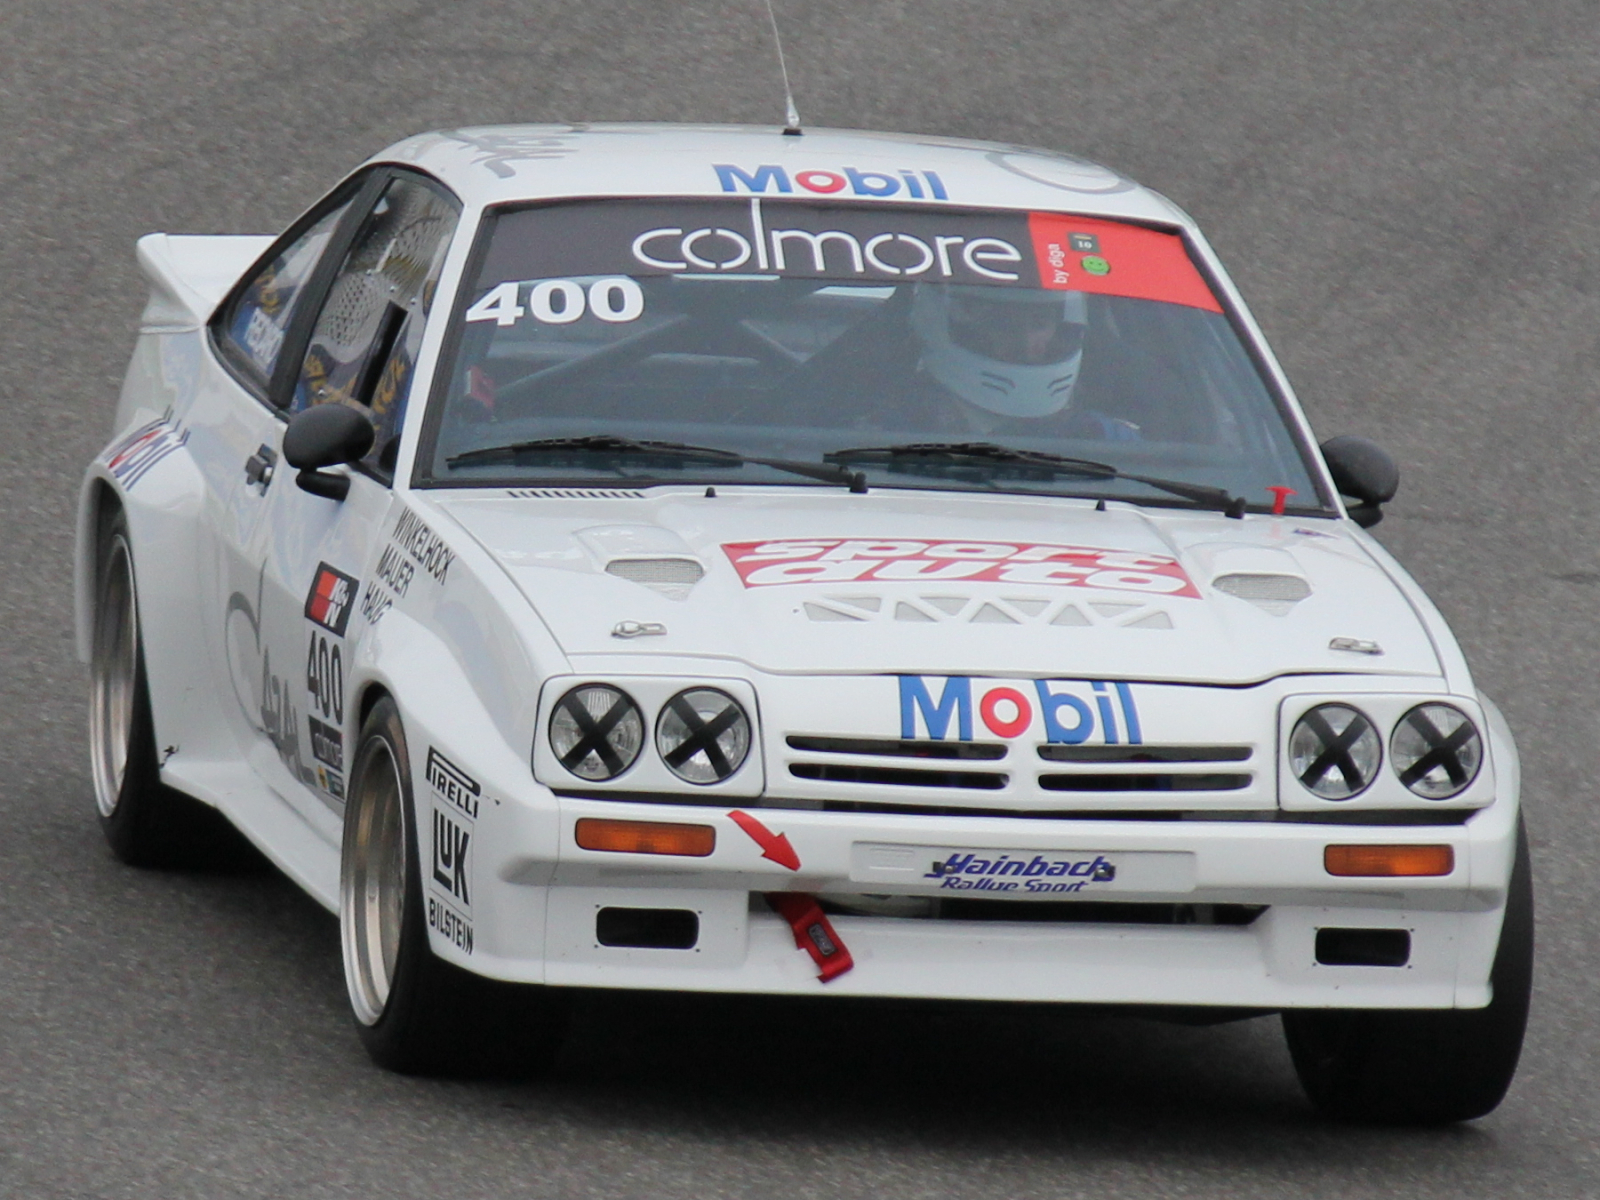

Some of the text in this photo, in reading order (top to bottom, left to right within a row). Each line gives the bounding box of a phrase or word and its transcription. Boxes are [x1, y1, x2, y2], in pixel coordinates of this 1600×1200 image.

[712, 164, 949, 200] Mobil
[632, 198, 1023, 281] colmore
[465, 278, 645, 327] 400
[1053, 269, 1070, 284] by
[375, 543, 415, 599] MAUER
[391, 505, 455, 586] WINKELHOCK
[735, 540, 1176, 570] sport
[360, 580, 393, 626] HAUG
[745, 558, 1188, 594] auto
[307, 629, 344, 726] 400
[897, 675, 1143, 745] Mobil
[425, 745, 482, 819] PIRELLI
[428, 897, 474, 957] BILSTEIN
